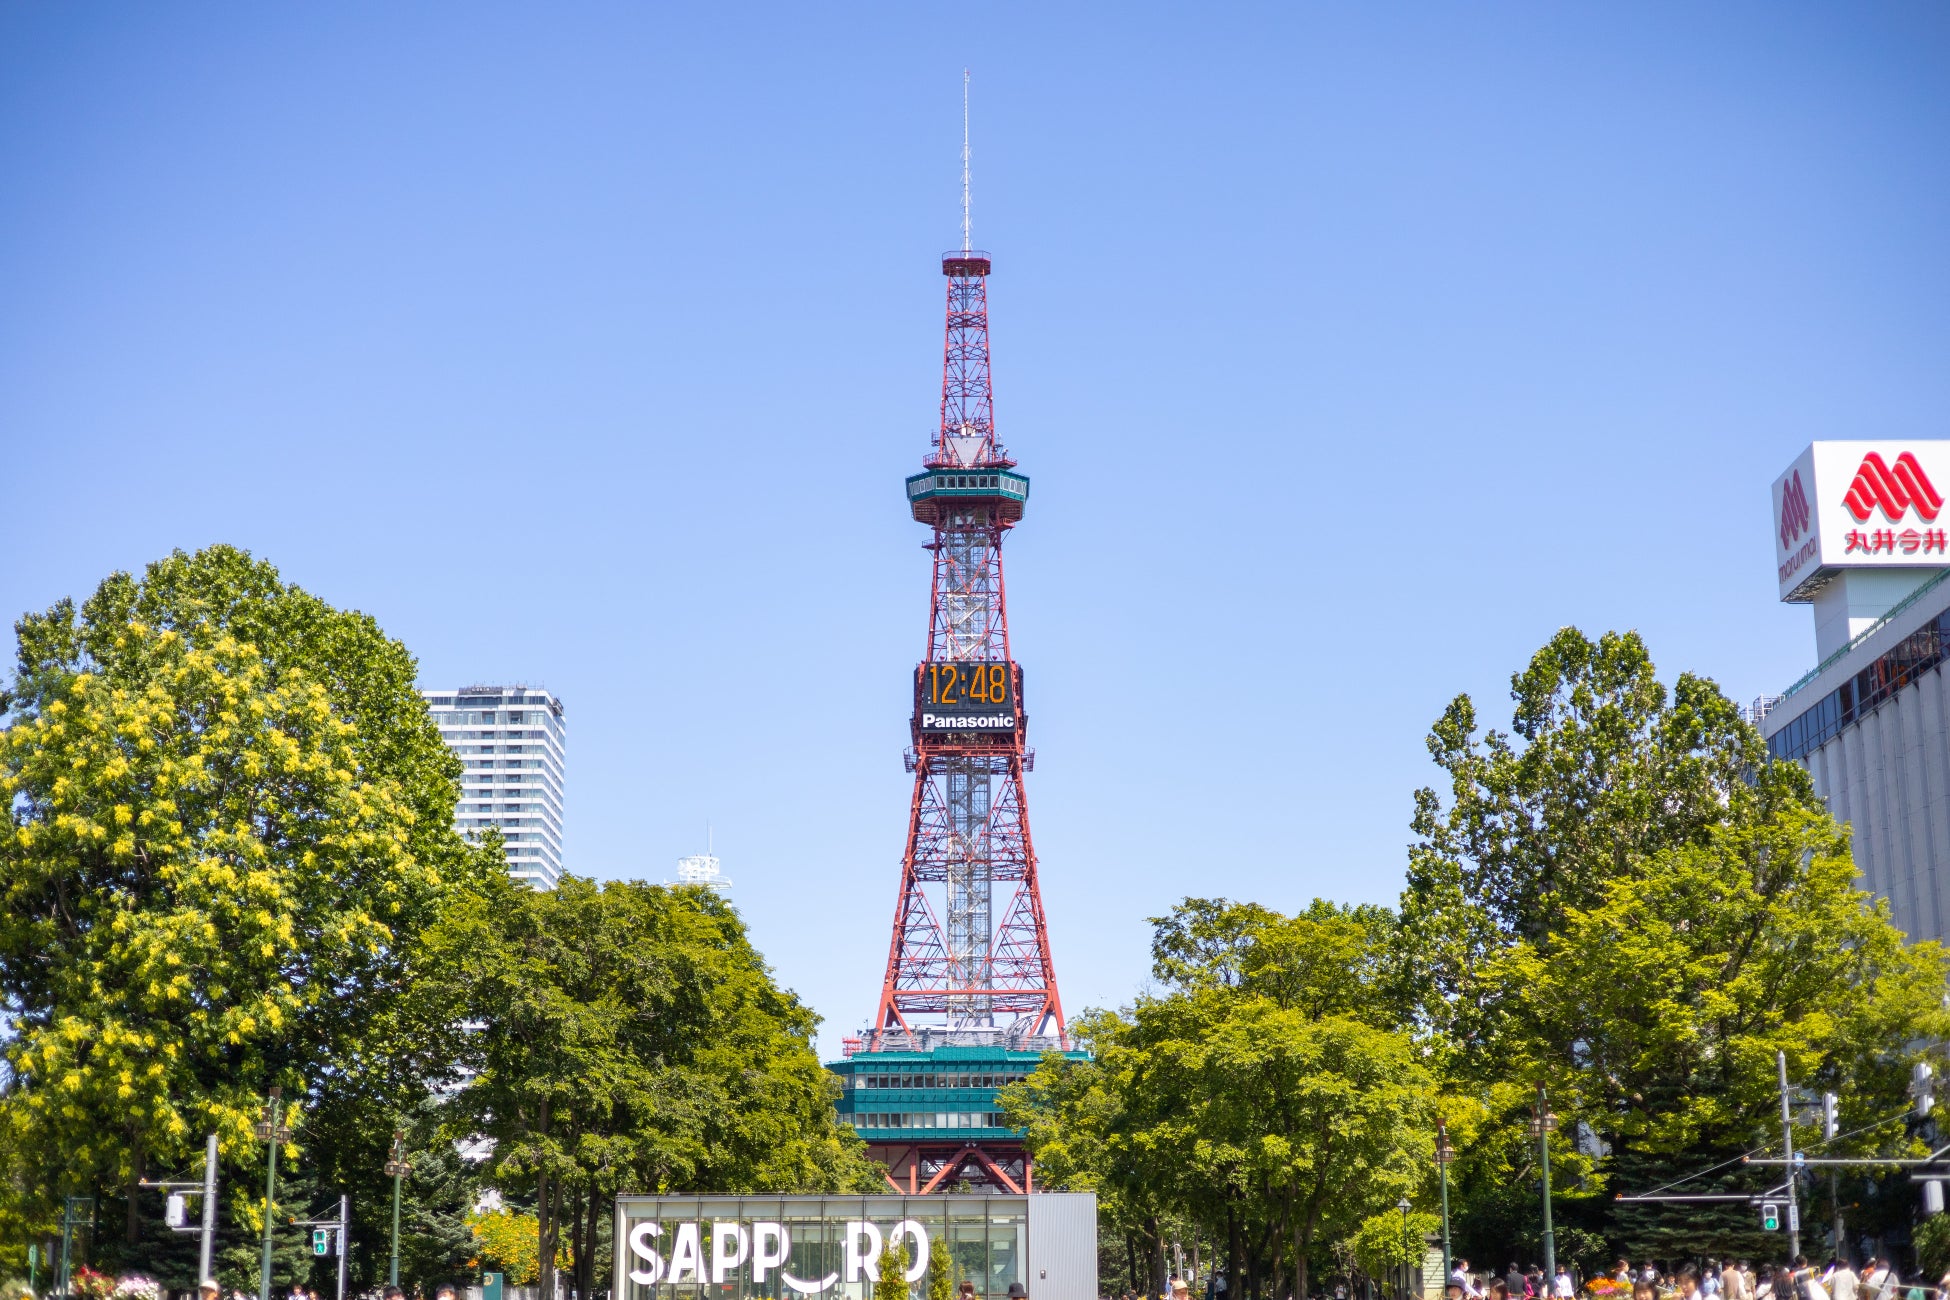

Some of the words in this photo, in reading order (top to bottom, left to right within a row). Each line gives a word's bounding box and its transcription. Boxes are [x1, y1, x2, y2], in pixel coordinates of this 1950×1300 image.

[1846, 528, 1949, 553] 丸井今井
[930, 665, 1005, 703] 12:48
[922, 713, 1014, 728] Panasonic
